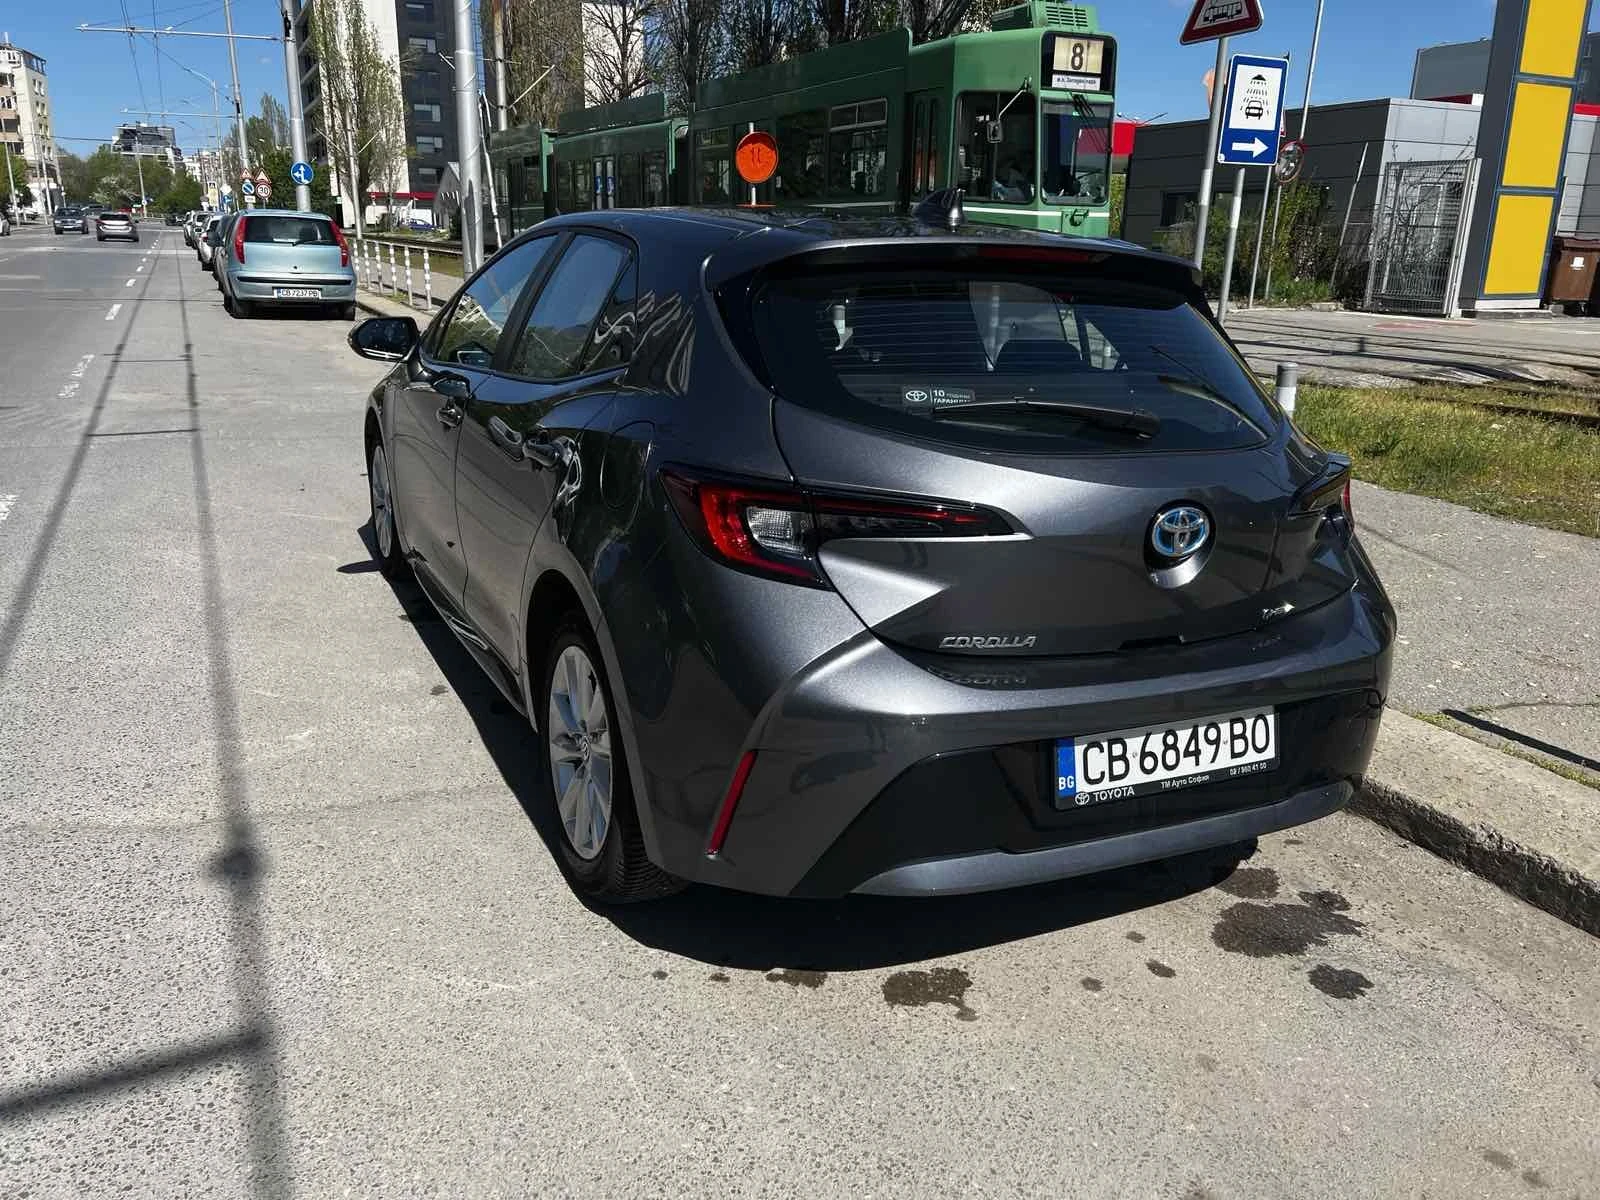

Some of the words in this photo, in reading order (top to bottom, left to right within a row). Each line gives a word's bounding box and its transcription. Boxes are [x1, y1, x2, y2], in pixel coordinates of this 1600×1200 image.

[1071, 42, 1084, 70] 8
[259, 187, 268, 195] 30
[933, 389, 945, 397] 10
[939, 636, 1037, 649] COROLLA
[1083, 738, 1130, 785] CB
[1139, 722, 1222, 776] 6849
[1058, 775, 1075, 790] BG
[1093, 786, 1135, 802] TOYOTA
